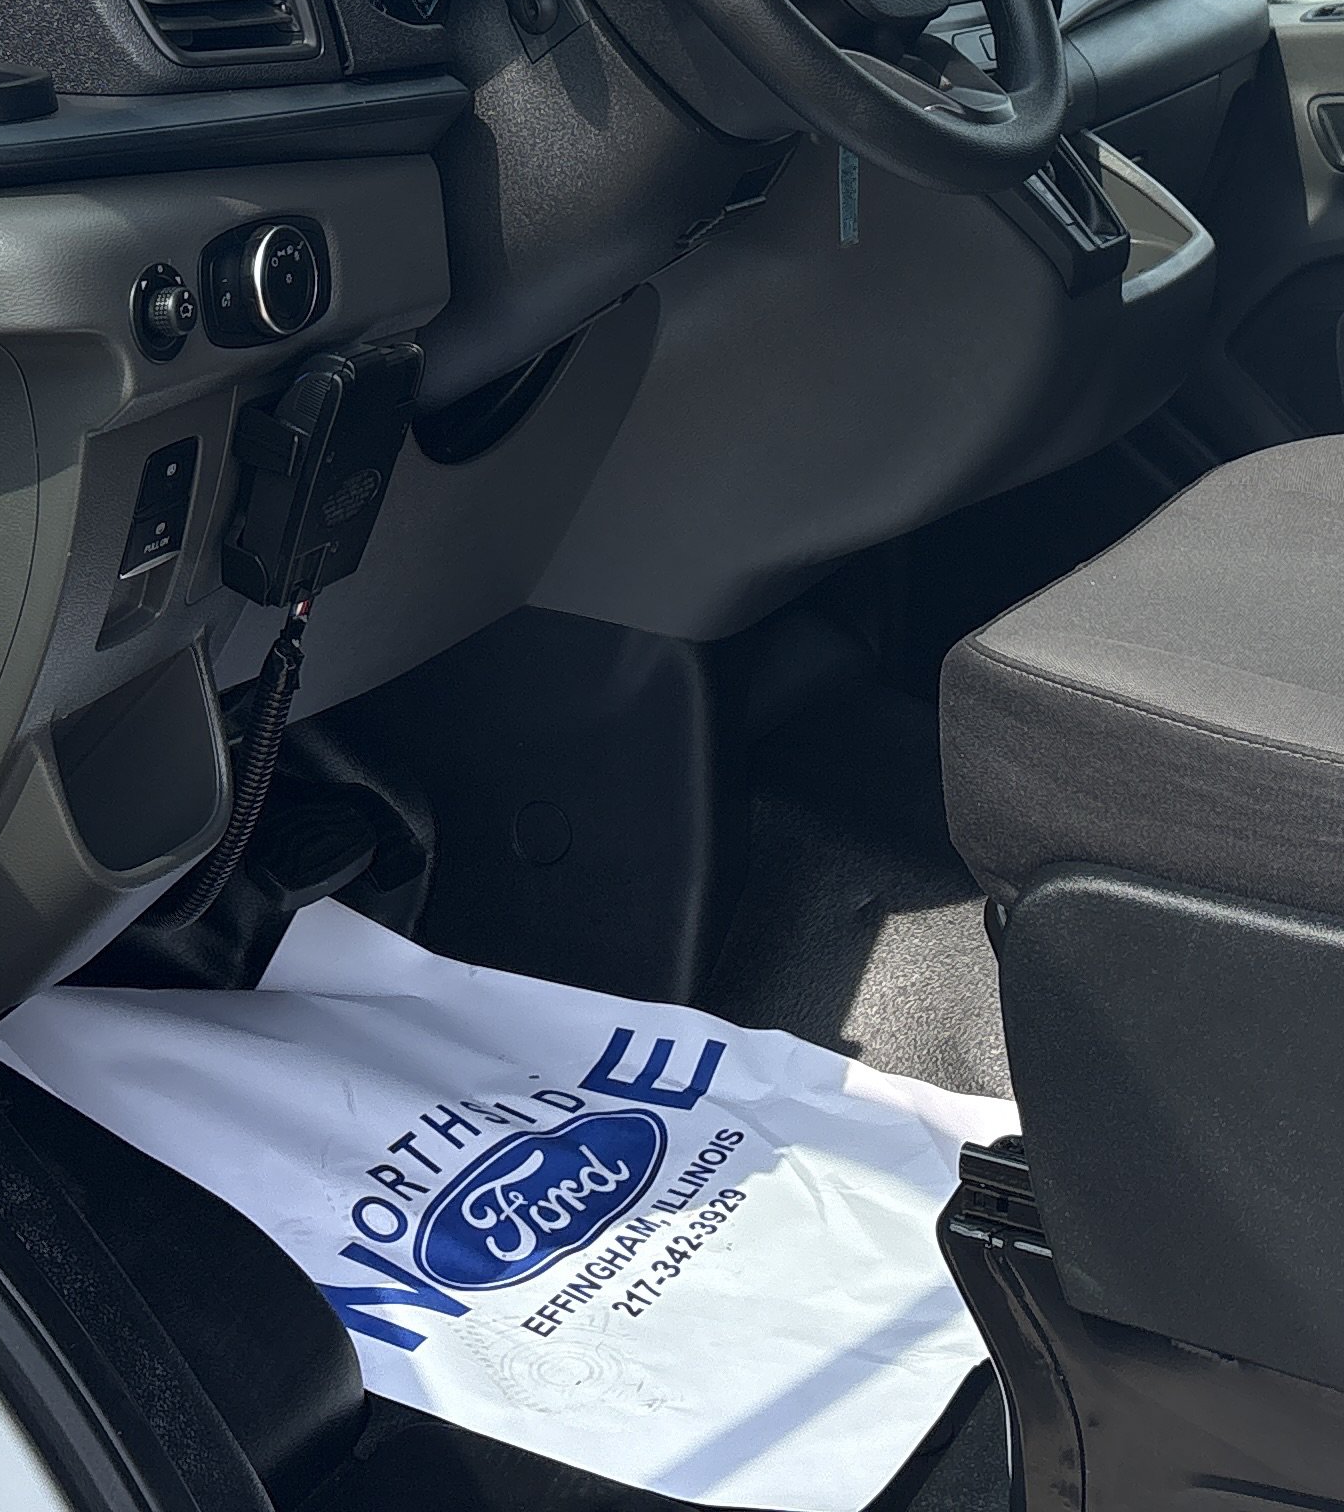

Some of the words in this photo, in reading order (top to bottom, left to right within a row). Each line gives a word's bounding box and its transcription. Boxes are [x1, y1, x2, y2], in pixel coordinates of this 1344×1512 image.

[313, 1027, 727, 1352] NORTHSIDE
[462, 1144, 631, 1262] Ford
[520, 1216, 672, 1338] EFFINGHAM,
[650, 1128, 745, 1215] ILLINOIS
[611, 1188, 747, 1318] 217-342-3929
